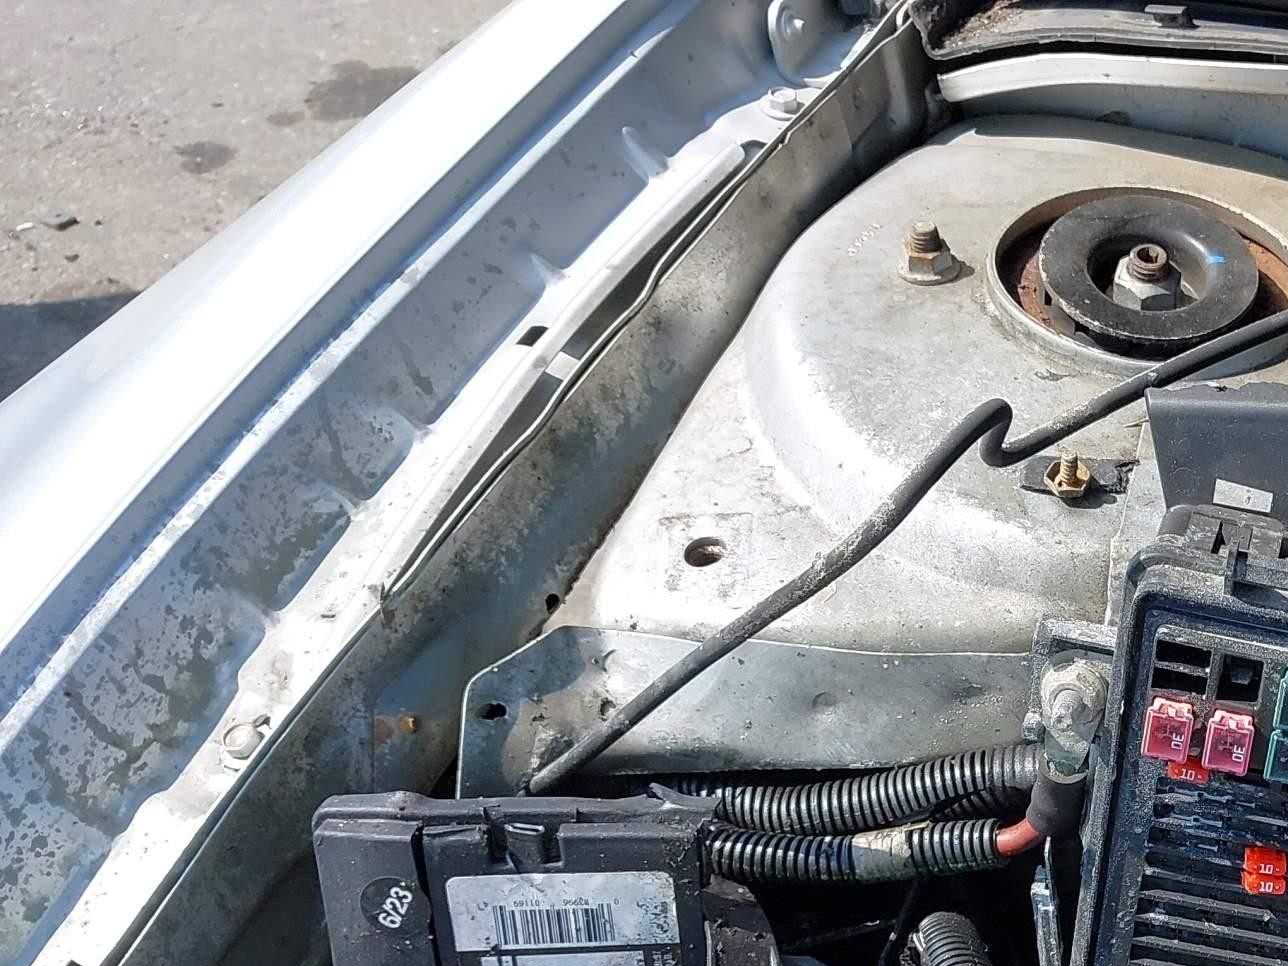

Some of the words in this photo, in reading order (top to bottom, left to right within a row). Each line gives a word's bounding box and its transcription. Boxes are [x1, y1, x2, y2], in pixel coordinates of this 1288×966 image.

[1170, 732, 1185, 750] 30
[1231, 745, 1246, 763] 30
[1180, 768, 1195, 781] 10
[1258, 863, 1274, 875] 10
[1258, 880, 1274, 892] 10
[378, 886, 413, 928] 6/23
